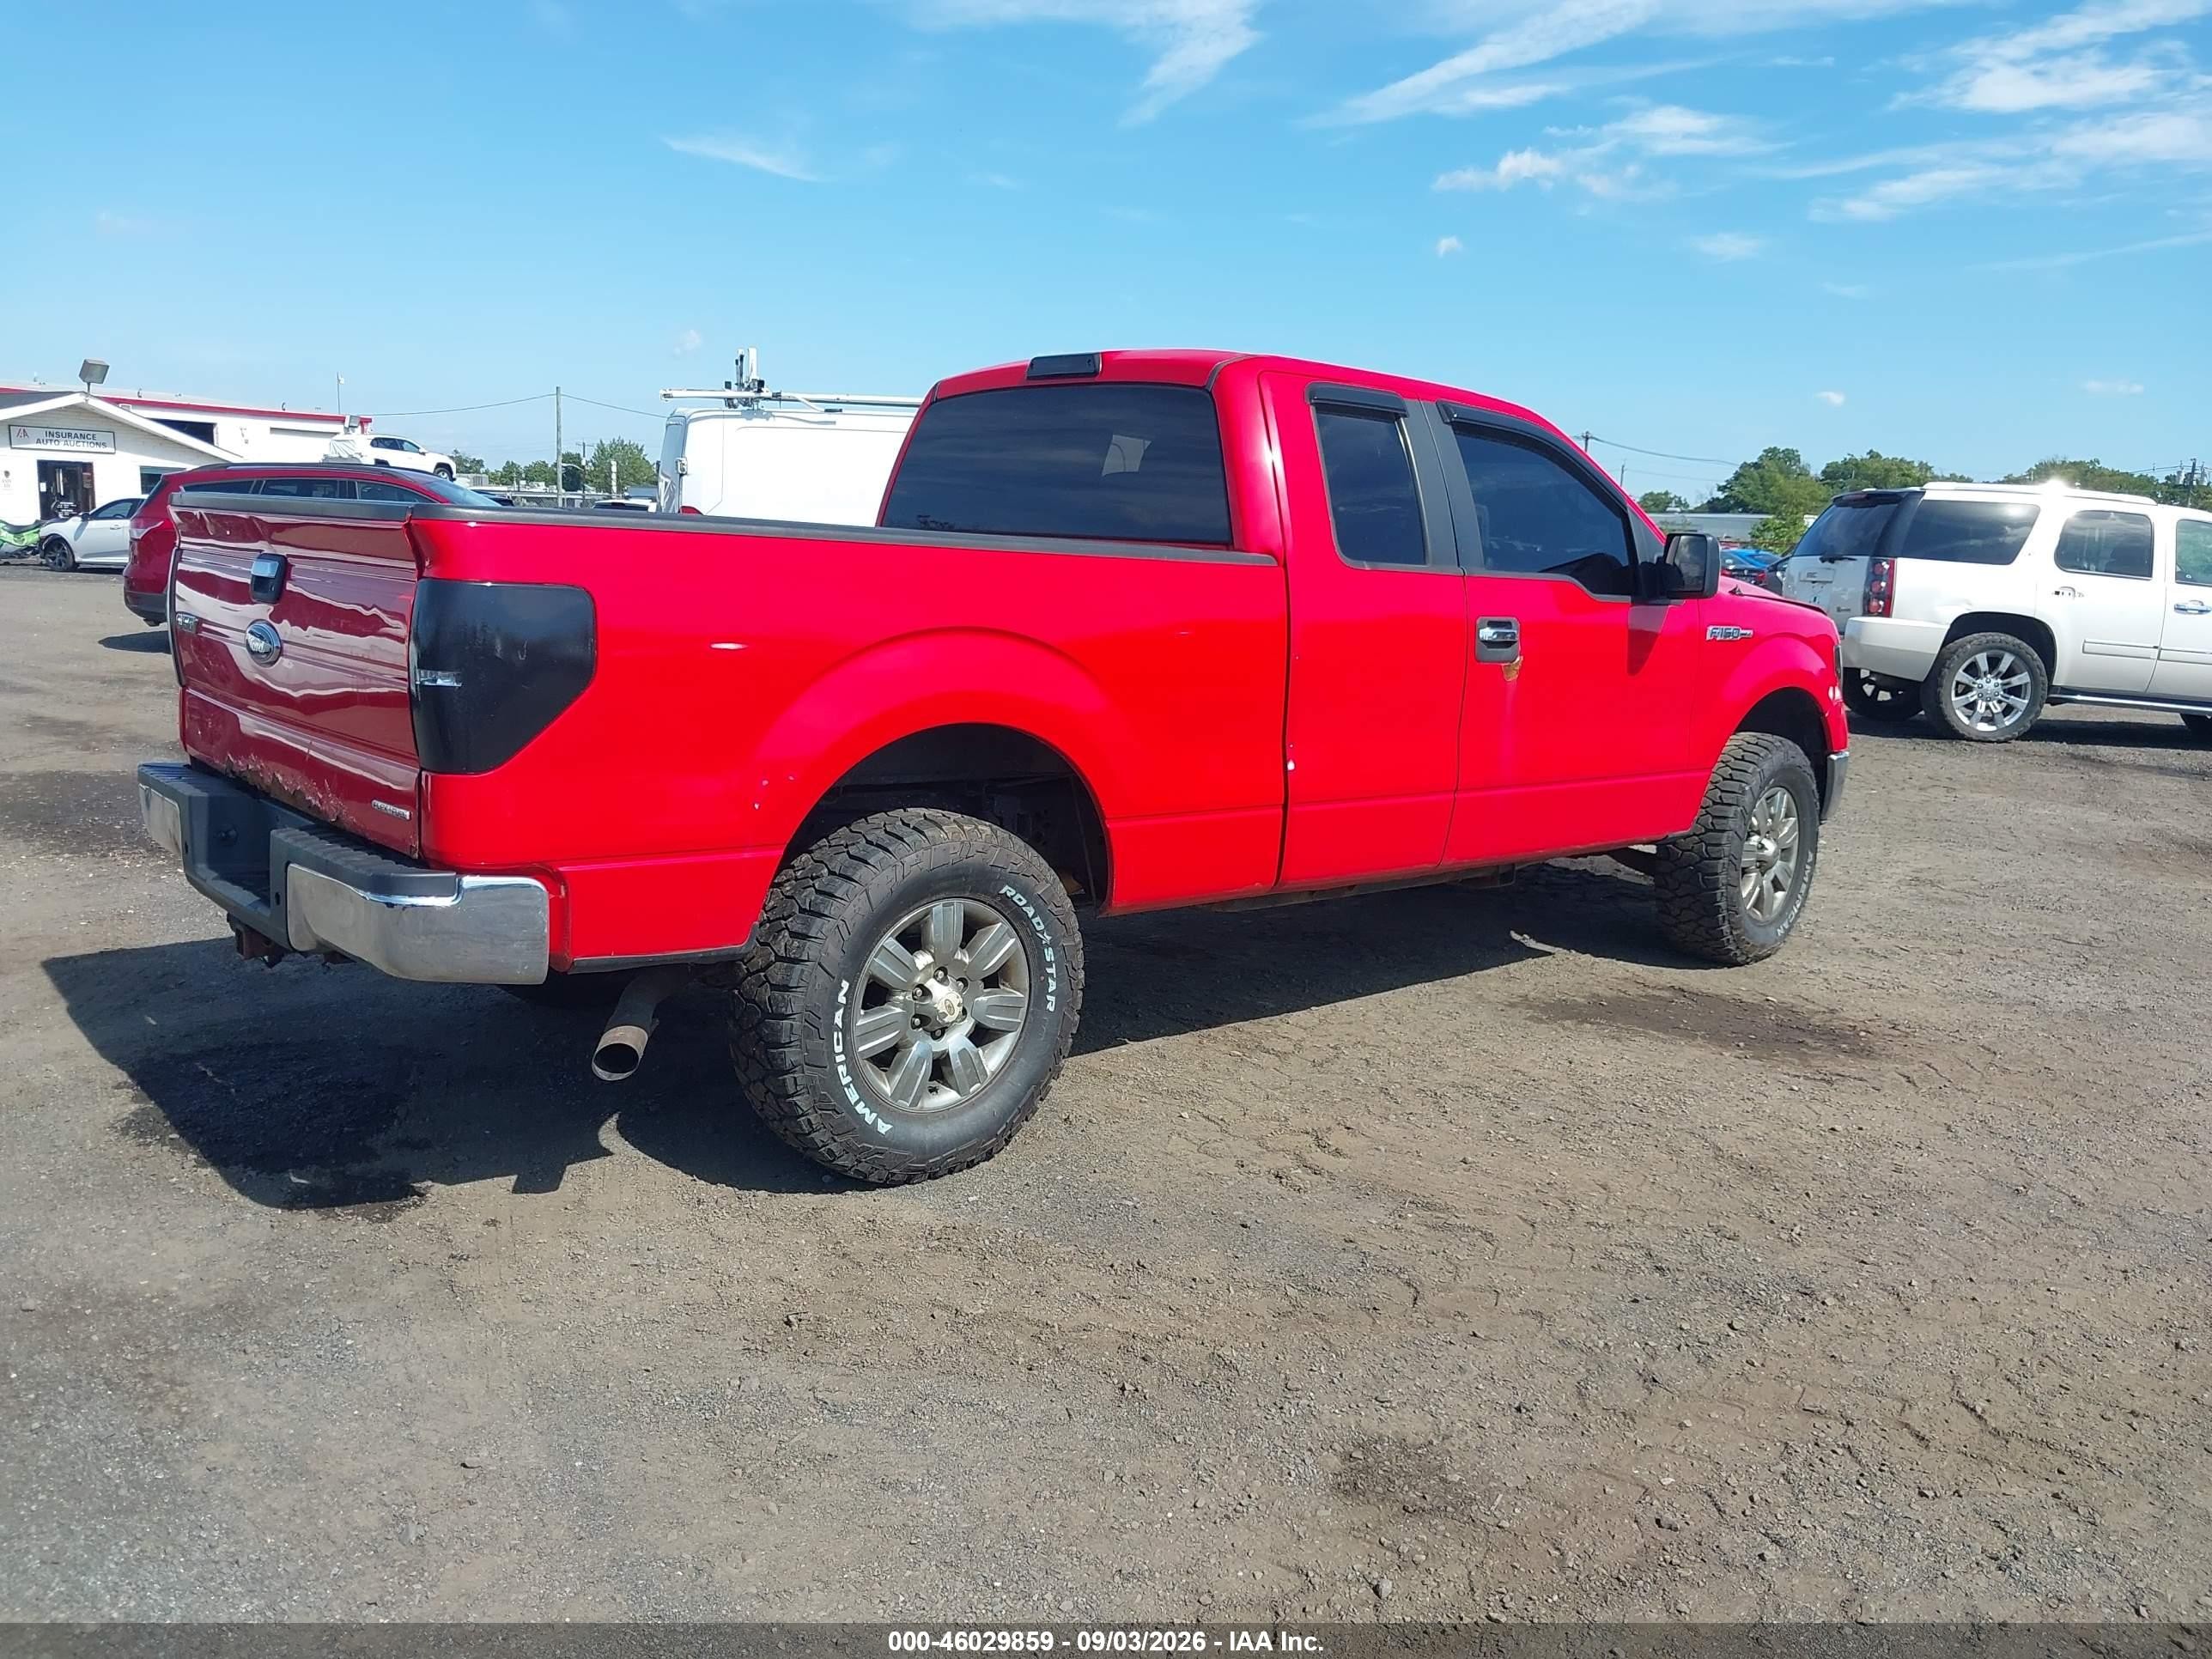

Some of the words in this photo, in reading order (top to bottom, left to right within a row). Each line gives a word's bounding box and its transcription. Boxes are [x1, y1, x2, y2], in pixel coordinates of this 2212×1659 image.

[36, 438, 61, 447] AUTO
[64, 440, 107, 448] AUCTIONS
[45, 430, 97, 441] INSURANCE
[1777, 850, 1814, 937] AMERICAN
[833, 979, 894, 1135] AMERICAN
